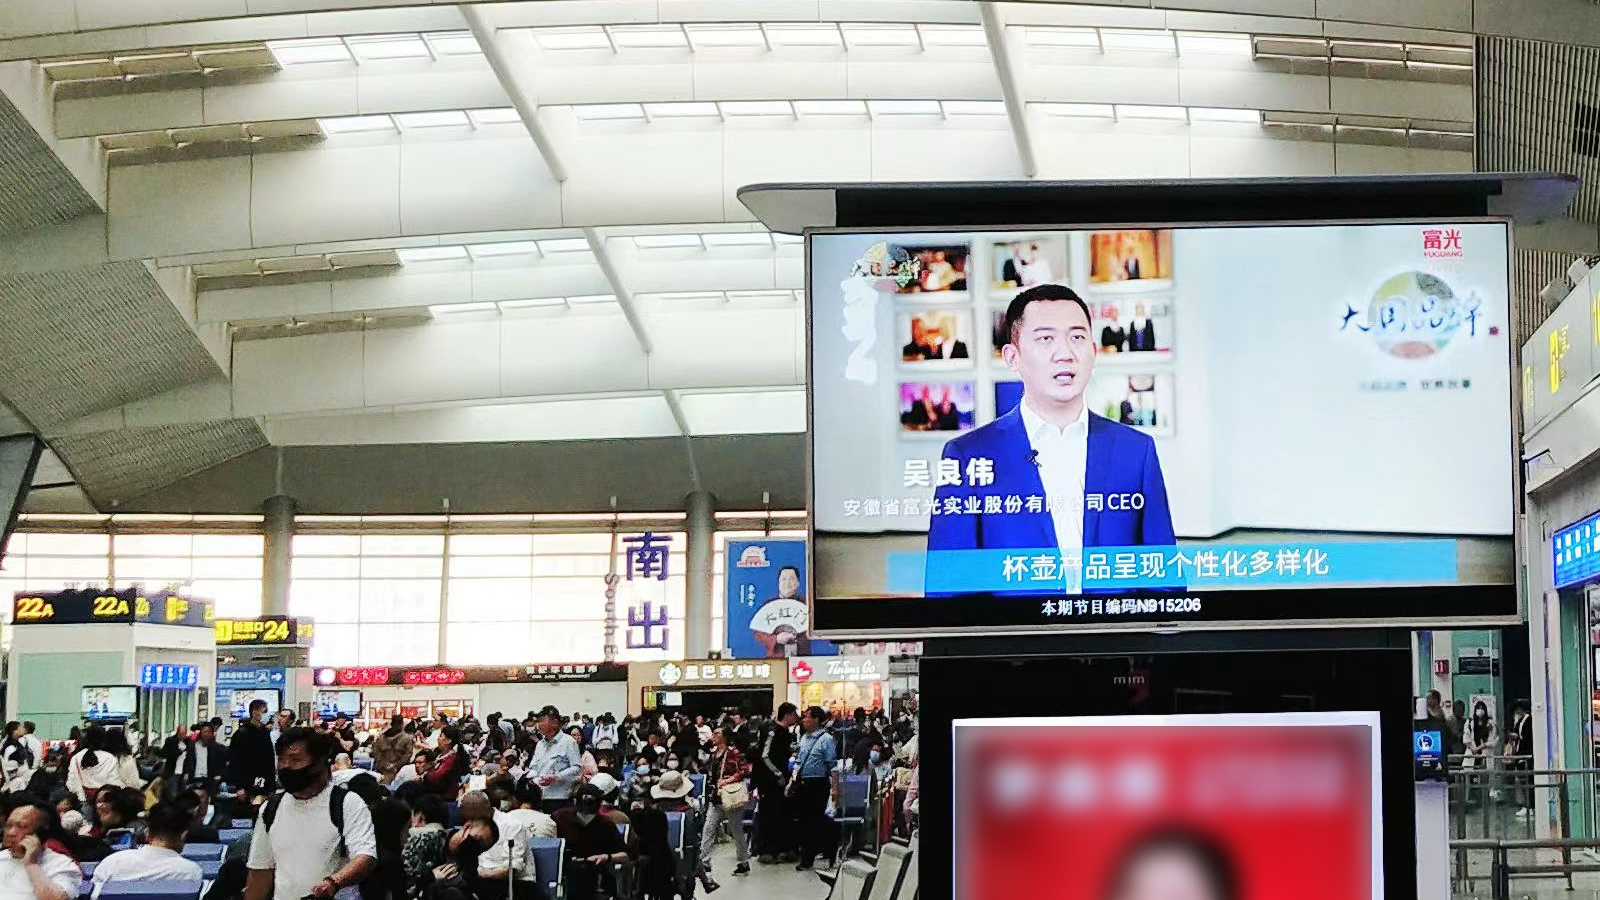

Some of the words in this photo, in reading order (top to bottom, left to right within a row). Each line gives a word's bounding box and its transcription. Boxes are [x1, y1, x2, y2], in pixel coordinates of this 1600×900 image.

[1422, 229, 1462, 250] 富光
[903, 457, 995, 487] 吴良伟
[1001, 548, 1330, 583] 杯壶产品呈现个性化多样化
[17, 598, 54, 619] 22A
[93, 597, 129, 615] 22A
[1041, 597, 1202, 616] 本期节目编码N915206
[264, 620, 290, 641] 24
